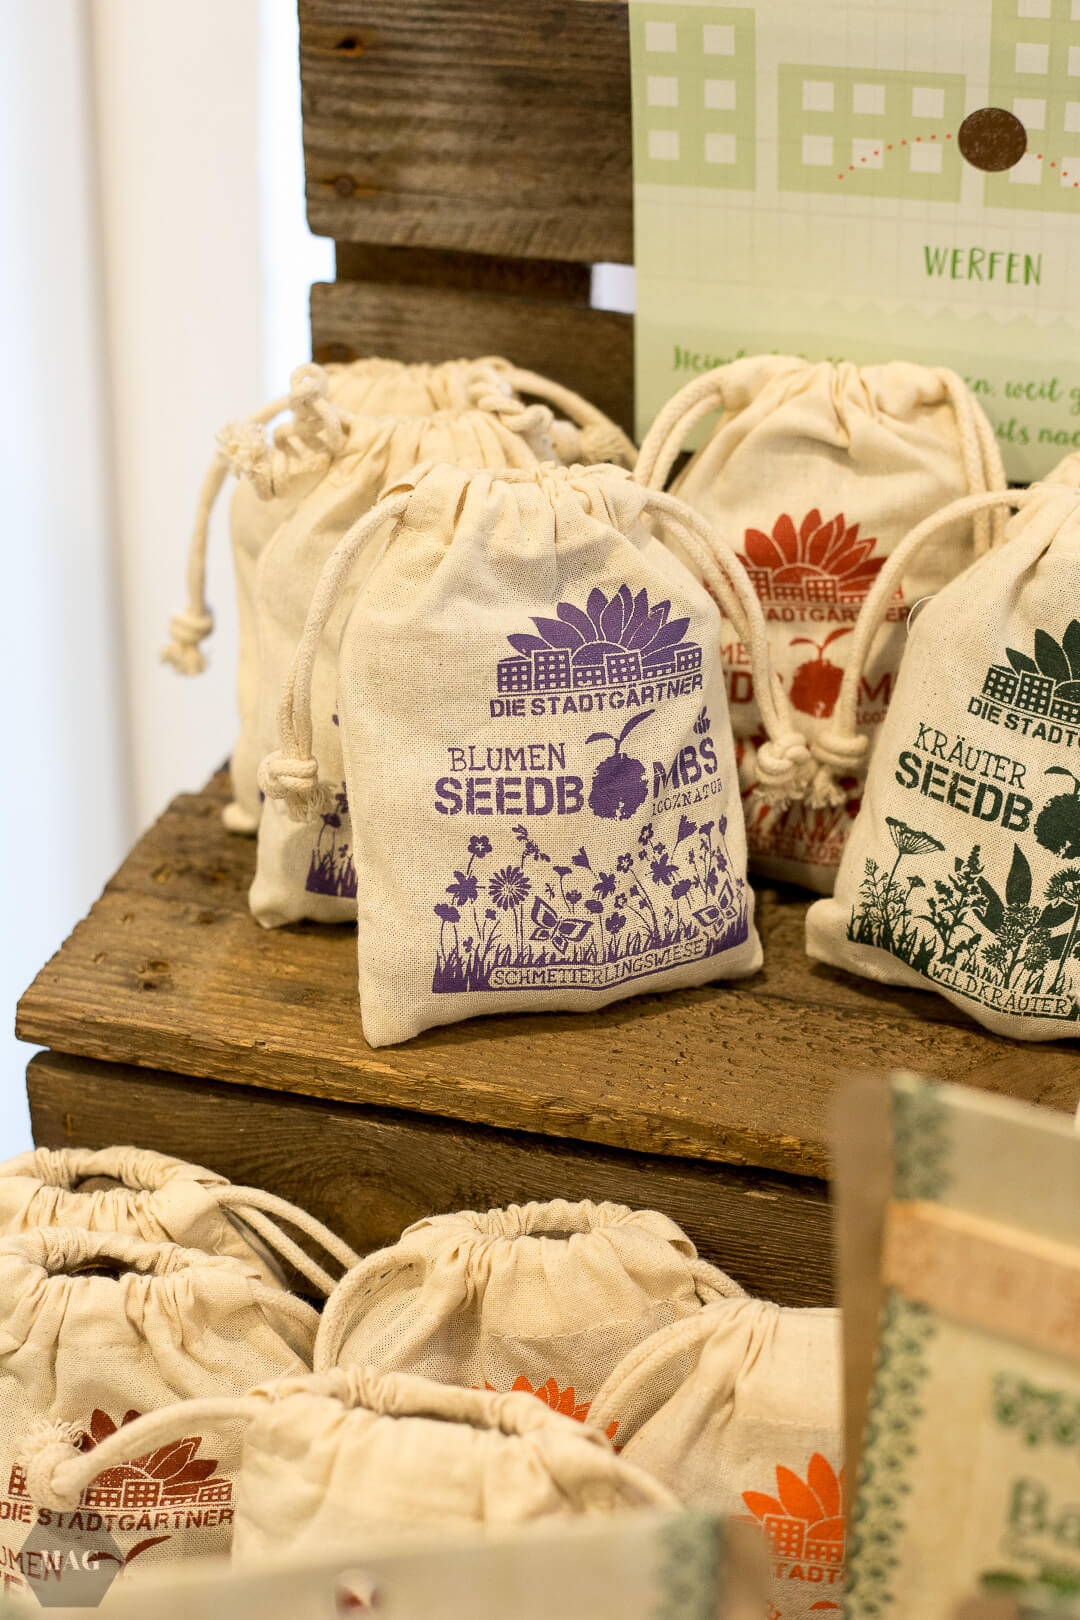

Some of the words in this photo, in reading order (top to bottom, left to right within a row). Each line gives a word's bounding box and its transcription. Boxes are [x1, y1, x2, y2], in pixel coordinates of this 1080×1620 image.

[924, 246, 1042, 286] WERFEN
[490, 699, 526, 718] DIE
[530, 673, 703, 717] STADTGÄRTNER
[968, 696, 1002, 725] DIE
[1004, 713, 1080, 747] STADT
[447, 743, 566, 772] BLUMEN
[912, 722, 1026, 790] KRÄUTER
[493, 940, 703, 986] SCHMETTERLINGSWIESE
[933, 963, 1069, 1014] WILDKRÄUTER
[0, 1501, 33, 1523] DIE
[37, 1507, 235, 1532] STADTGÄRTNER
